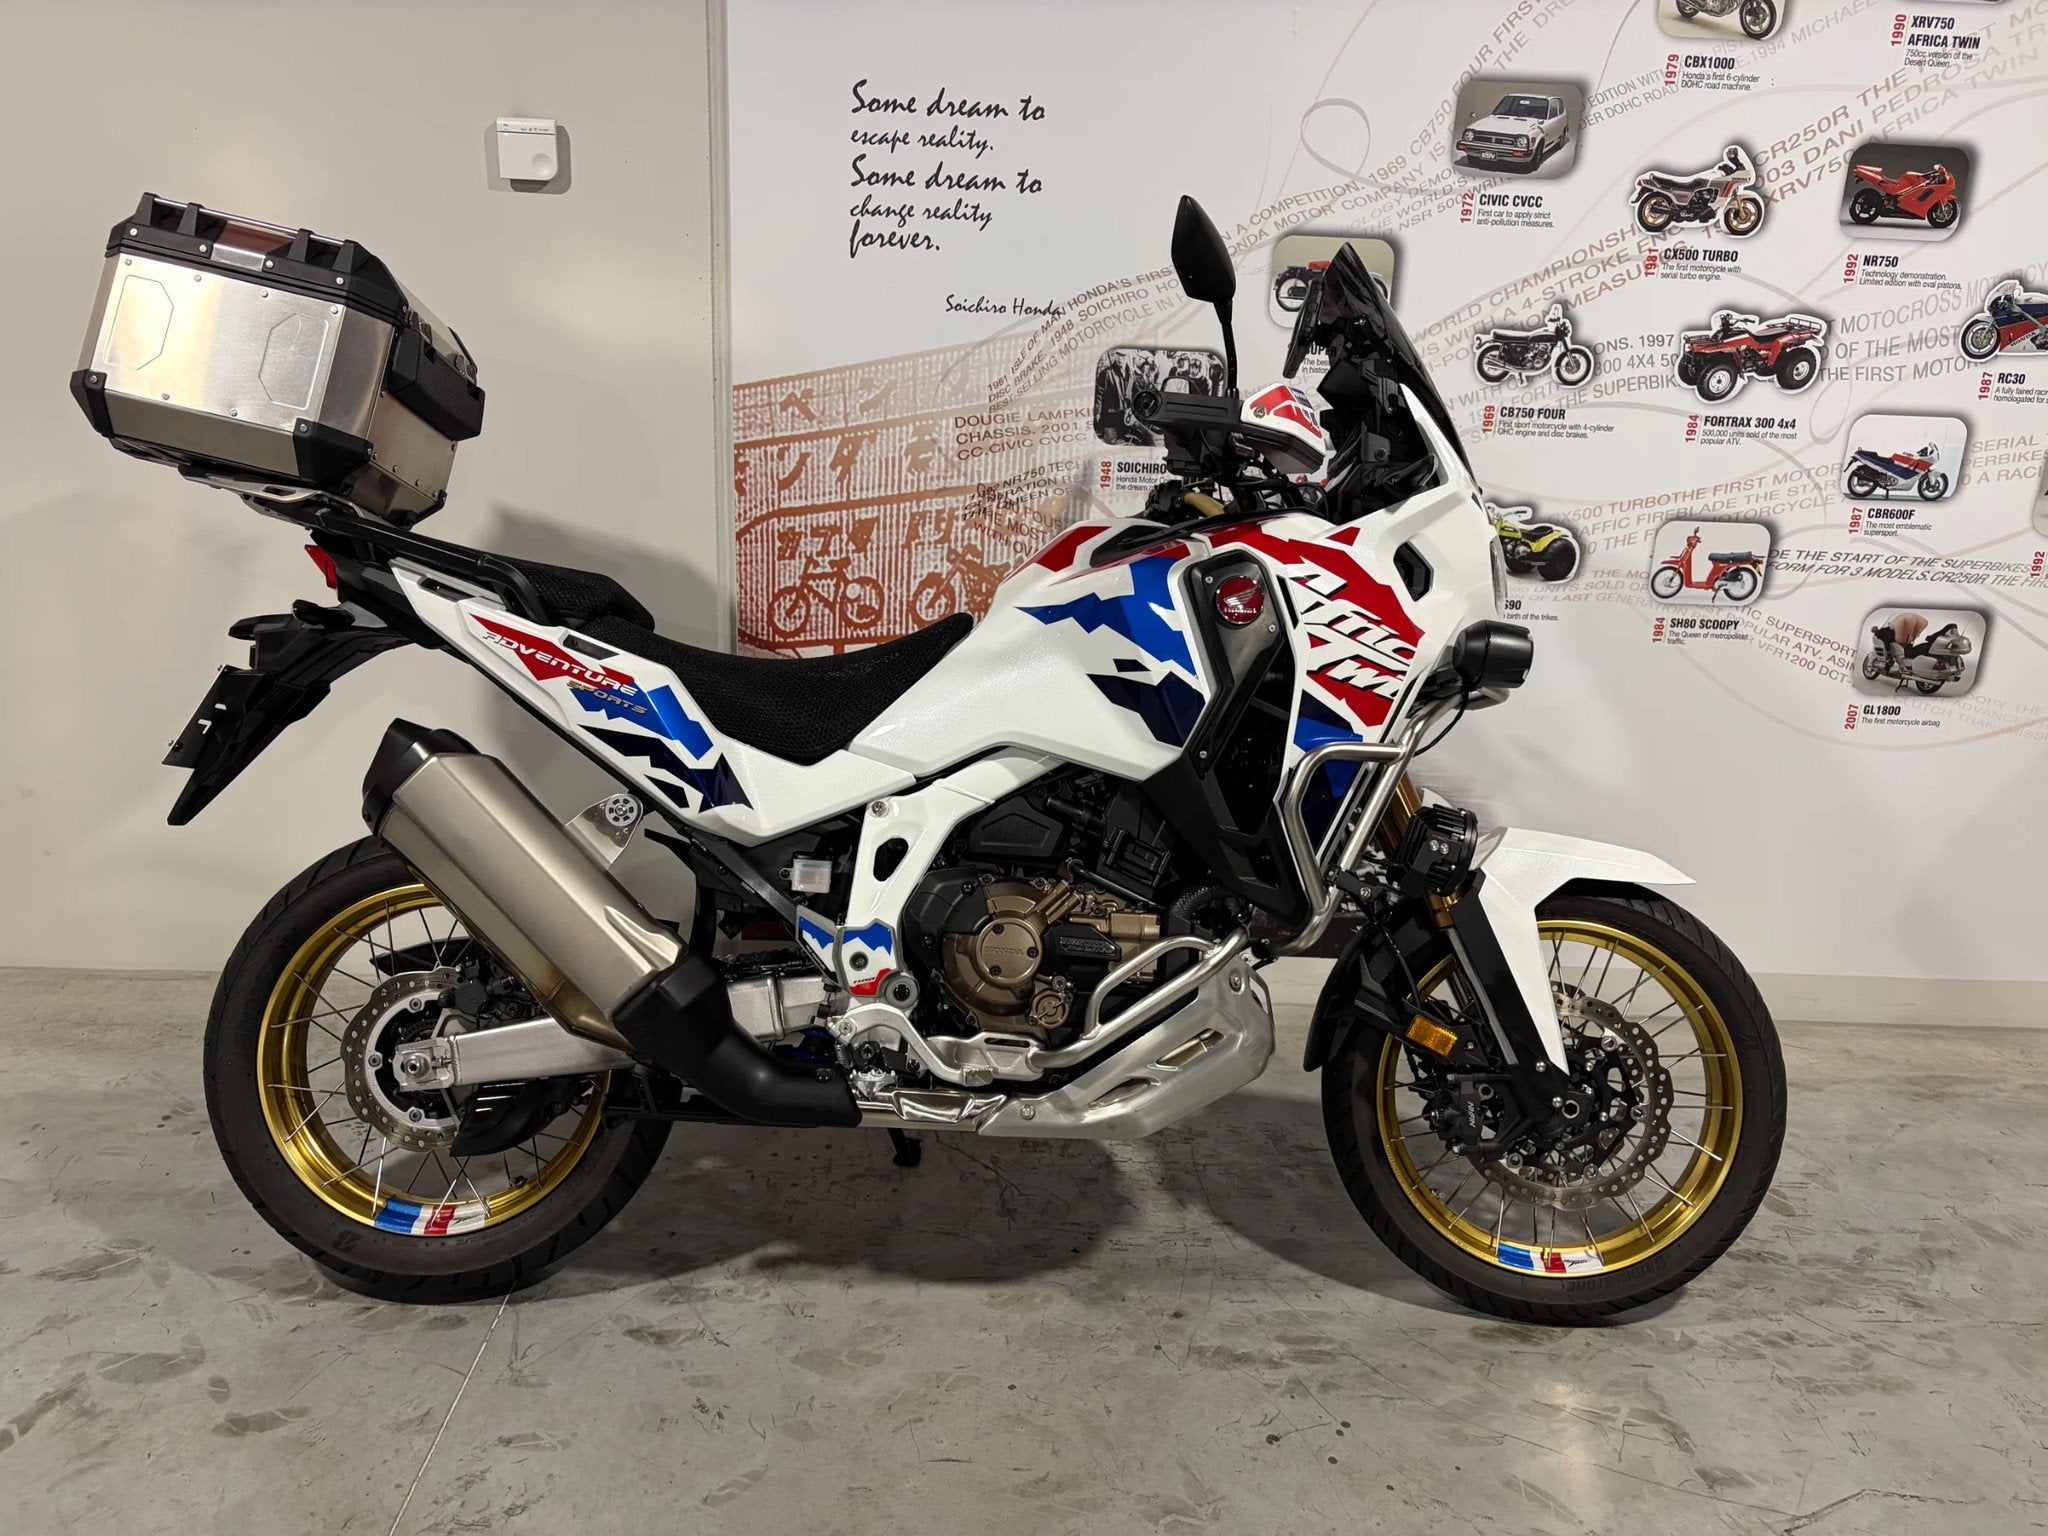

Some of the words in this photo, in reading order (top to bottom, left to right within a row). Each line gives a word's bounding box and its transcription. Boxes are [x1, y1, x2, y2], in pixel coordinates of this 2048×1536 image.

[1891, 14, 1907, 46] 1990
[1911, 15, 1955, 30] XRV750
[1493, 31, 1530, 71] THE
[1907, 34, 1949, 48] AFRICA
[1952, 36, 1981, 49] TWIN
[1684, 55, 1735, 70] CBX1000
[1904, 58, 1926, 67] Desert
[1927, 59, 1952, 68] Queen.
[1905, 49, 1927, 58] 750cc
[1928, 50, 1952, 59] version
[1664, 54, 1679, 86] 1979
[1681, 71, 1711, 80] Honda's
[1712, 72, 1725, 80] first
[1726, 73, 1760, 83] 6-cylinder
[1589, 79, 1636, 110] EDITION
[1681, 80, 1703, 89] DOHC
[1704, 81, 1721, 89] road
[1721, 82, 1752, 91] machine.
[1856, 68, 1907, 106] THE
[851, 79, 917, 113] Some
[926, 87, 1009, 118] dream
[1018, 95, 1045, 121] to
[1604, 97, 1642, 119] DOHC
[1410, 99, 1453, 155] CB750
[1754, 104, 1850, 167] CR250R
[850, 129, 910, 154] escape
[917, 125, 994, 160] reality.
[1803, 119, 1864, 164] DANI
[851, 153, 916, 187] Some
[925, 161, 1006, 192] dream
[1015, 169, 1043, 194] to
[1250, 180, 1366, 226] COMPETITION.
[1369, 155, 1406, 184] 1969
[1274, 203, 1335, 231] MOTOR
[1341, 163, 1424, 211] COMPANY
[1460, 191, 1475, 224] 1972
[1479, 193, 1509, 207] CIVIC
[1512, 195, 1543, 208] CVCC
[850, 194, 914, 228] change
[922, 198, 992, 231] reality
[1477, 209, 1493, 217] First
[1514, 211, 1532, 220] apply
[1533, 211, 1551, 219] strict
[1476, 218, 1520, 228] anti-pollution
[1520, 219, 1555, 228] measures.
[850, 219, 940, 258] forever.
[1645, 248, 1659, 277] 1981
[1663, 248, 1698, 261] CX500
[1702, 250, 1739, 262] TURBO
[1863, 255, 1899, 268] NR750
[1662, 263, 1674, 271] The
[1676, 264, 1688, 272] first
[1689, 265, 1727, 274] motorcycle
[1843, 254, 1859, 283] 1992
[1860, 269, 1899, 279] Technology
[1900, 271, 1947, 280] demonstration.
[1522, 247, 1631, 311] 4-STROKE
[1697, 274, 1721, 283] engine.
[1859, 278, 1884, 287] Limited
[1884, 280, 1907, 288] edition
[1922, 281, 1936, 289] oval
[1936, 282, 1962, 291] pistons.
[1067, 278, 1133, 311] HONDA'S
[945, 294, 1007, 314] Soichiro
[1013, 297, 1060, 316] Honda
[1840, 289, 1963, 335] MOTOCROSS
[1050, 319, 1075, 346] 1948
[1078, 288, 1149, 322] SOICHIRO
[1059, 303, 1155, 359] MOTORCYCLE
[1638, 334, 1675, 348] 1997
[1865, 335, 1900, 357] THE
[1627, 353, 1655, 370] 4X4
[1855, 364, 1907, 382] FIRST
[1997, 373, 2026, 385] RC30
[1978, 372, 1993, 400] 1987
[2001, 386, 2014, 395] fully
[2016, 387, 2034, 395] faired
[1993, 395, 2035, 404] homologated
[954, 412, 1021, 429] DOUGIE
[1482, 405, 1495, 434] 1969
[1500, 406, 1534, 418] CB750
[1537, 408, 1566, 420] FOUR
[1703, 415, 1752, 428] FORTRAX
[1754, 417, 1775, 429] 300
[1777, 418, 1797, 430] 4x4
[956, 426, 1036, 445] CHASSIS.
[1041, 421, 1079, 434] 2001
[1499, 420, 1513, 428] First
[1514, 421, 1531, 429] sport
[1531, 422, 1567, 431] motorcycle
[1583, 424, 1614, 433] 4-cylinder
[1515, 429, 1537, 438] engine
[1551, 430, 1565, 438] disc
[1565, 431, 1588, 439] brakes.
[1685, 415, 1700, 443] 1984
[1702, 429, 1728, 438] 500,000
[1728, 430, 1745, 438] units
[1746, 430, 1760, 439] sold
[1780, 432, 1797, 440] most
[957, 438, 1034, 461] CC.CIVIC
[1038, 433, 1088, 449] CVCC
[1725, 438, 1741, 446] ATV.
[1971, 435, 2039, 453] SERIAL
[1100, 461, 1112, 489] 1948
[1117, 461, 1167, 474] SOICHIRO
[1003, 466, 1046, 489] NR750
[1116, 476, 1138, 484] Honda
[1713, 476, 1767, 497] FIRST
[1744, 489, 1779, 506] THE
[1849, 507, 1863, 535] 1987
[1867, 508, 1916, 520] CBR600F
[1864, 529, 1899, 537] supersport.
[1865, 520, 1878, 529] The
[1878, 521, 1895, 529] most
[1895, 522, 1932, 531] emblematic
[1796, 549, 1828, 561] THE
[1830, 551, 1884, 564] START
[1909, 556, 1942, 568] THE
[2030, 551, 2045, 578] 1992
[1814, 564, 1851, 575] FOR
[1990, 574, 2019, 586] THE
[1652, 617, 1665, 643] 1984
[1669, 617, 1697, 629] SH80
[1698, 619, 1740, 630] SCOOPY
[1681, 631, 1702, 639] Queen
[1709, 632, 1748, 640] metropolitan
[1792, 642, 1823, 659] ATV.
[482, 631, 639, 697] ADVENTURE
[566, 680, 648, 715] SPORTS
[1844, 704, 1859, 730] 2007
[1863, 704, 1901, 716] GL1800
[1861, 716, 1872, 725] The
[1873, 717, 1886, 725] first
[1886, 718, 1920, 727] motorcycle
[1921, 719, 1941, 728] airbag
